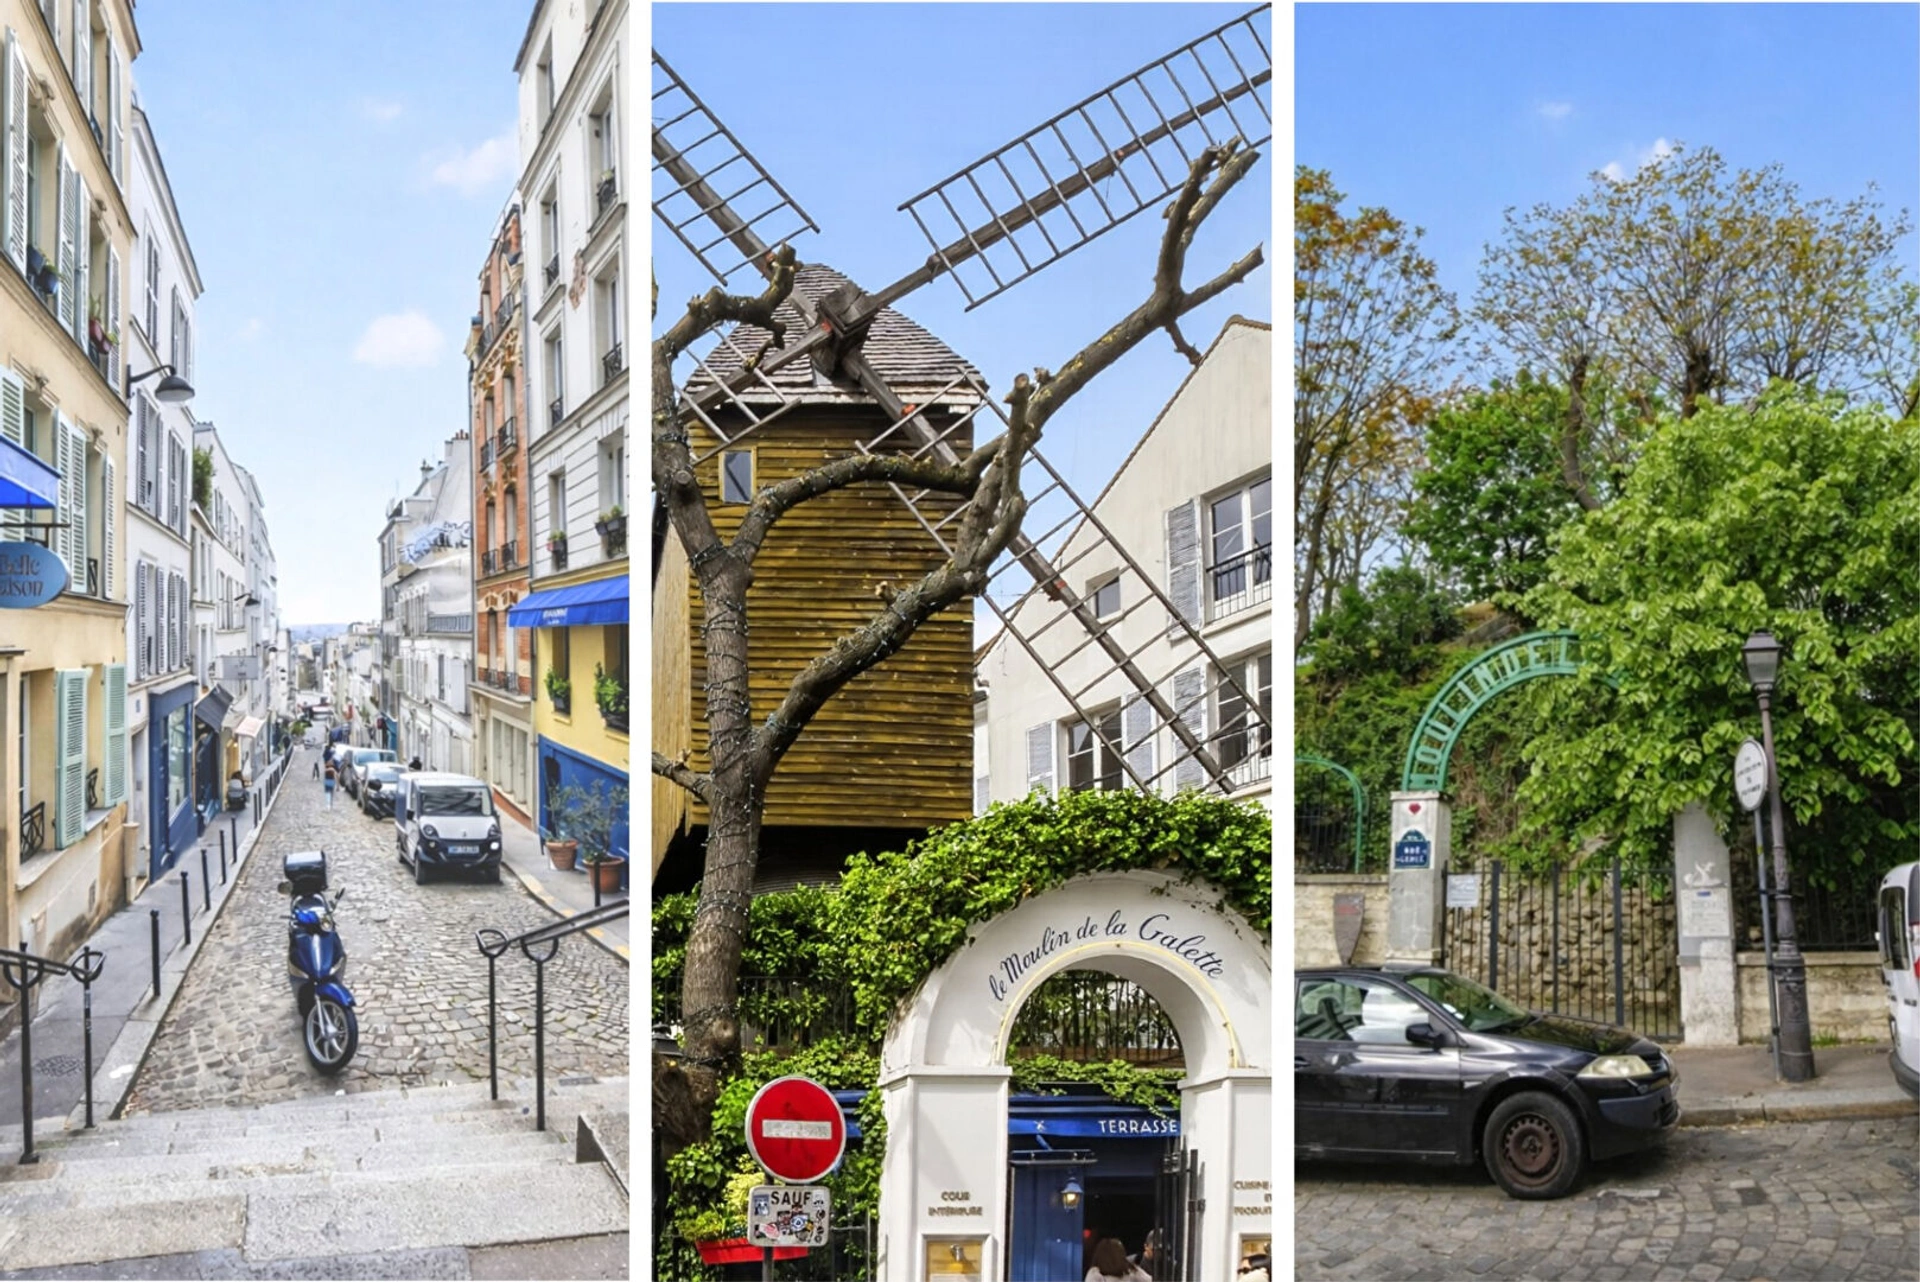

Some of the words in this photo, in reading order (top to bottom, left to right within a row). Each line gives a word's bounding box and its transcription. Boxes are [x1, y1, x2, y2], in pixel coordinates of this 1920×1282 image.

[1501, 640, 1546, 679] DE
[989, 974, 1008, 1001] le
[1001, 926, 1071, 983] Moulin
[1077, 916, 1098, 940] de
[1105, 909, 1127, 936] la
[1139, 914, 1224, 980] Galette
[1098, 1119, 1178, 1134] TERRASSE
[771, 1191, 812, 1205] SAUF
